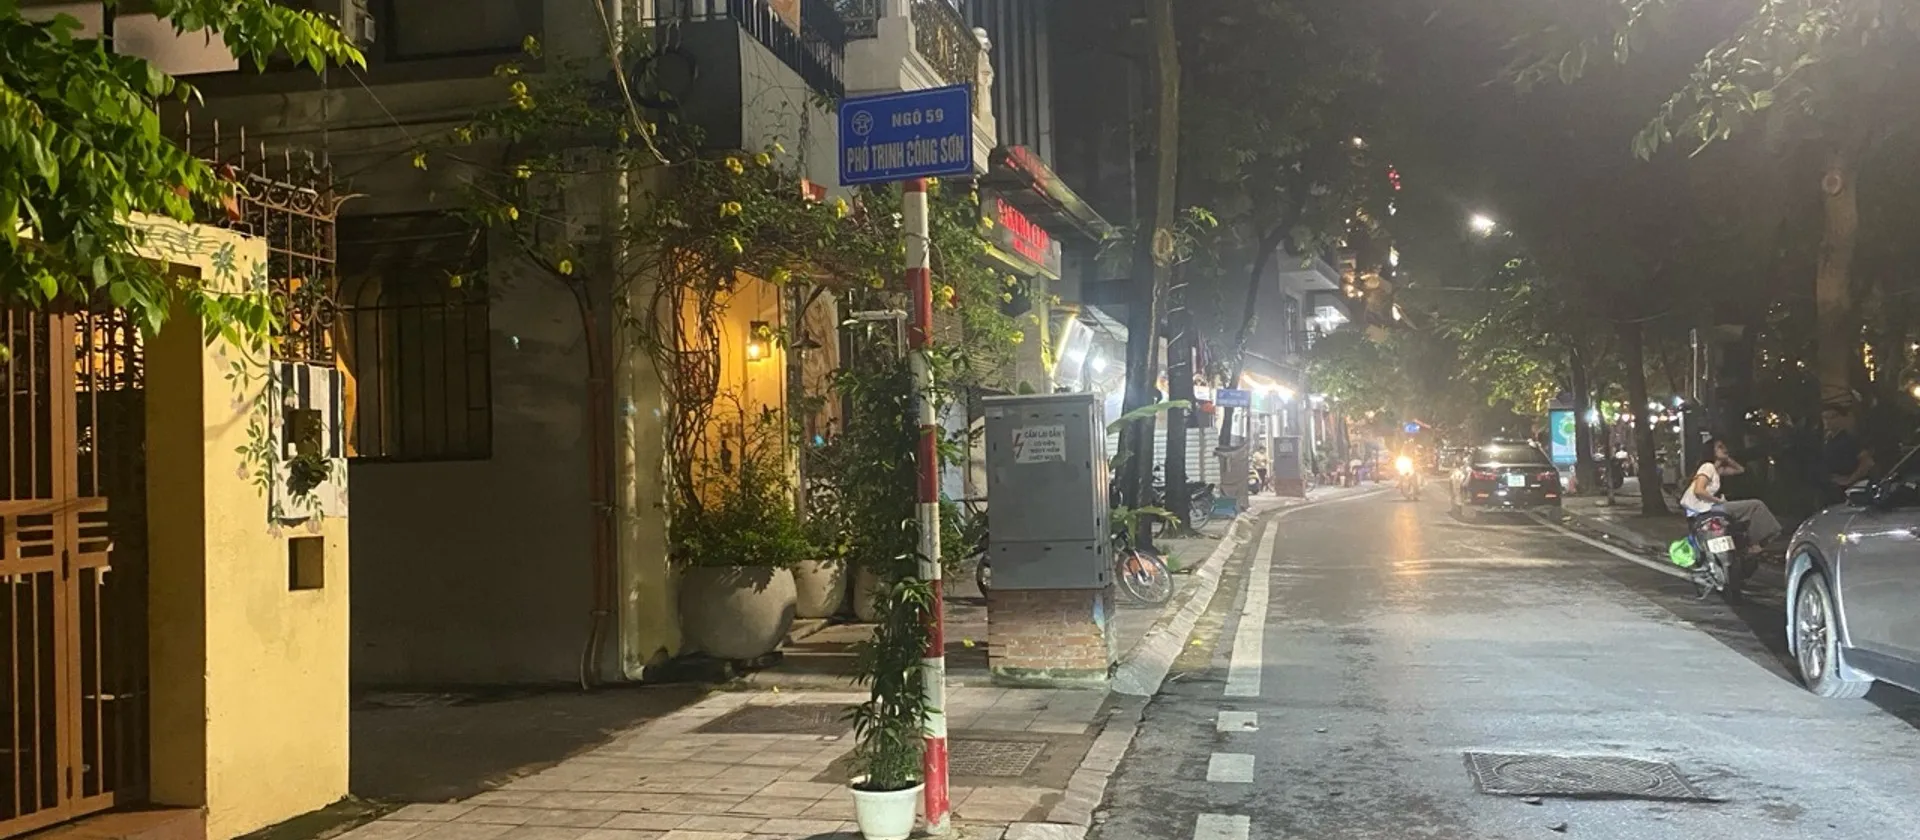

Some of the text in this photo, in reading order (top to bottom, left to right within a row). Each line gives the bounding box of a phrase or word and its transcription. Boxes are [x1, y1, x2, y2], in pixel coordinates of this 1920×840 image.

[925, 108, 944, 123] 59
[847, 132, 965, 175] PHỐ TRỊNH CÔNG SƠN
